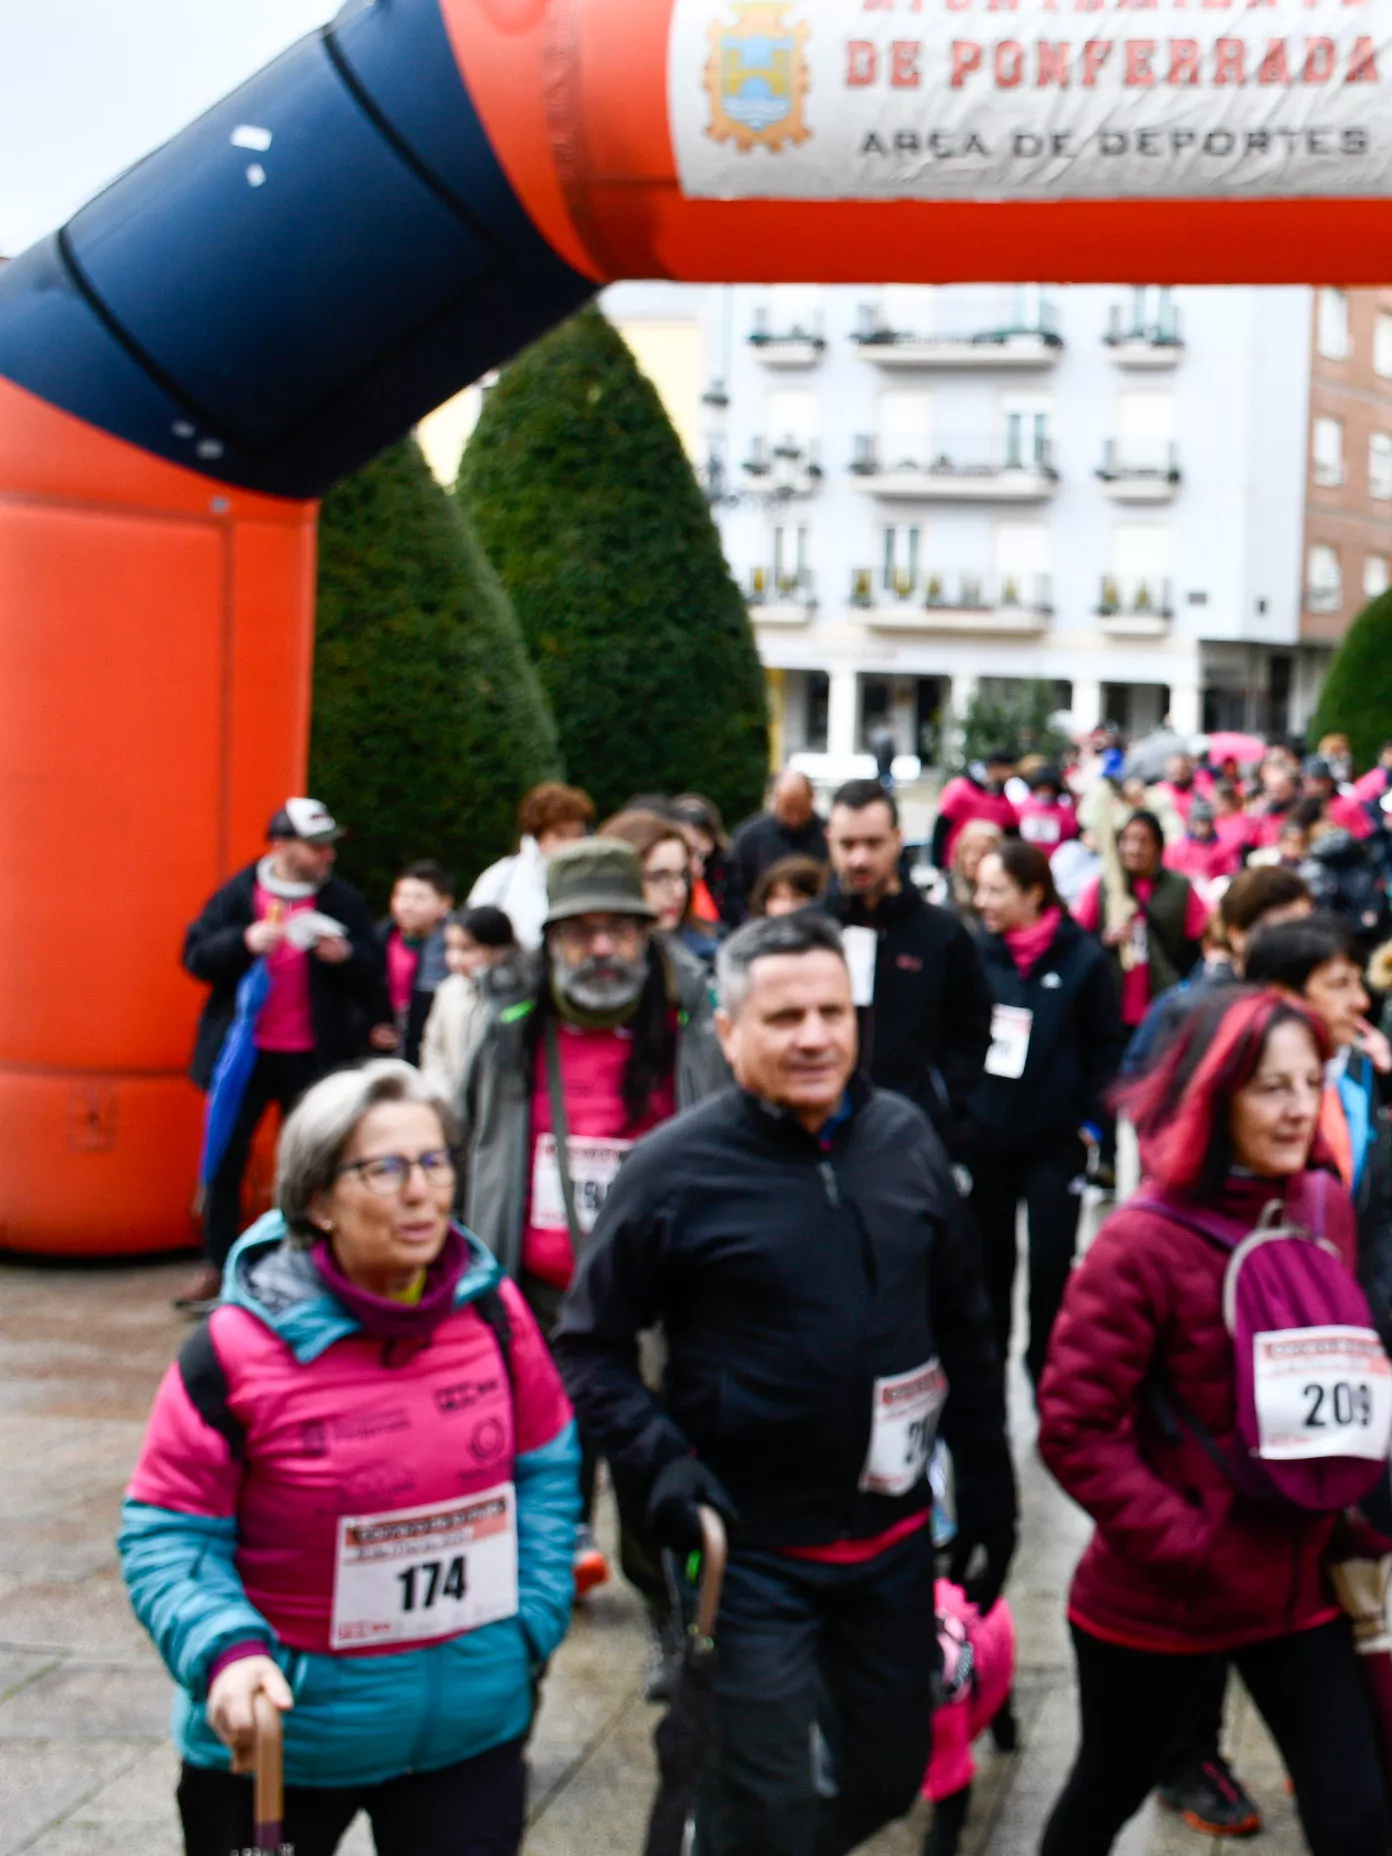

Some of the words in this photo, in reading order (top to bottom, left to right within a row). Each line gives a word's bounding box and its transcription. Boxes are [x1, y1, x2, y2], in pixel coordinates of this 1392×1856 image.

[846, 40, 921, 88] DE
[950, 36, 1380, 88] PONFERRADA
[860, 130, 994, 158] AREA
[1011, 132, 1082, 158] DE
[1096, 127, 1369, 157] DEPORTES
[397, 1554, 467, 1614] 174
